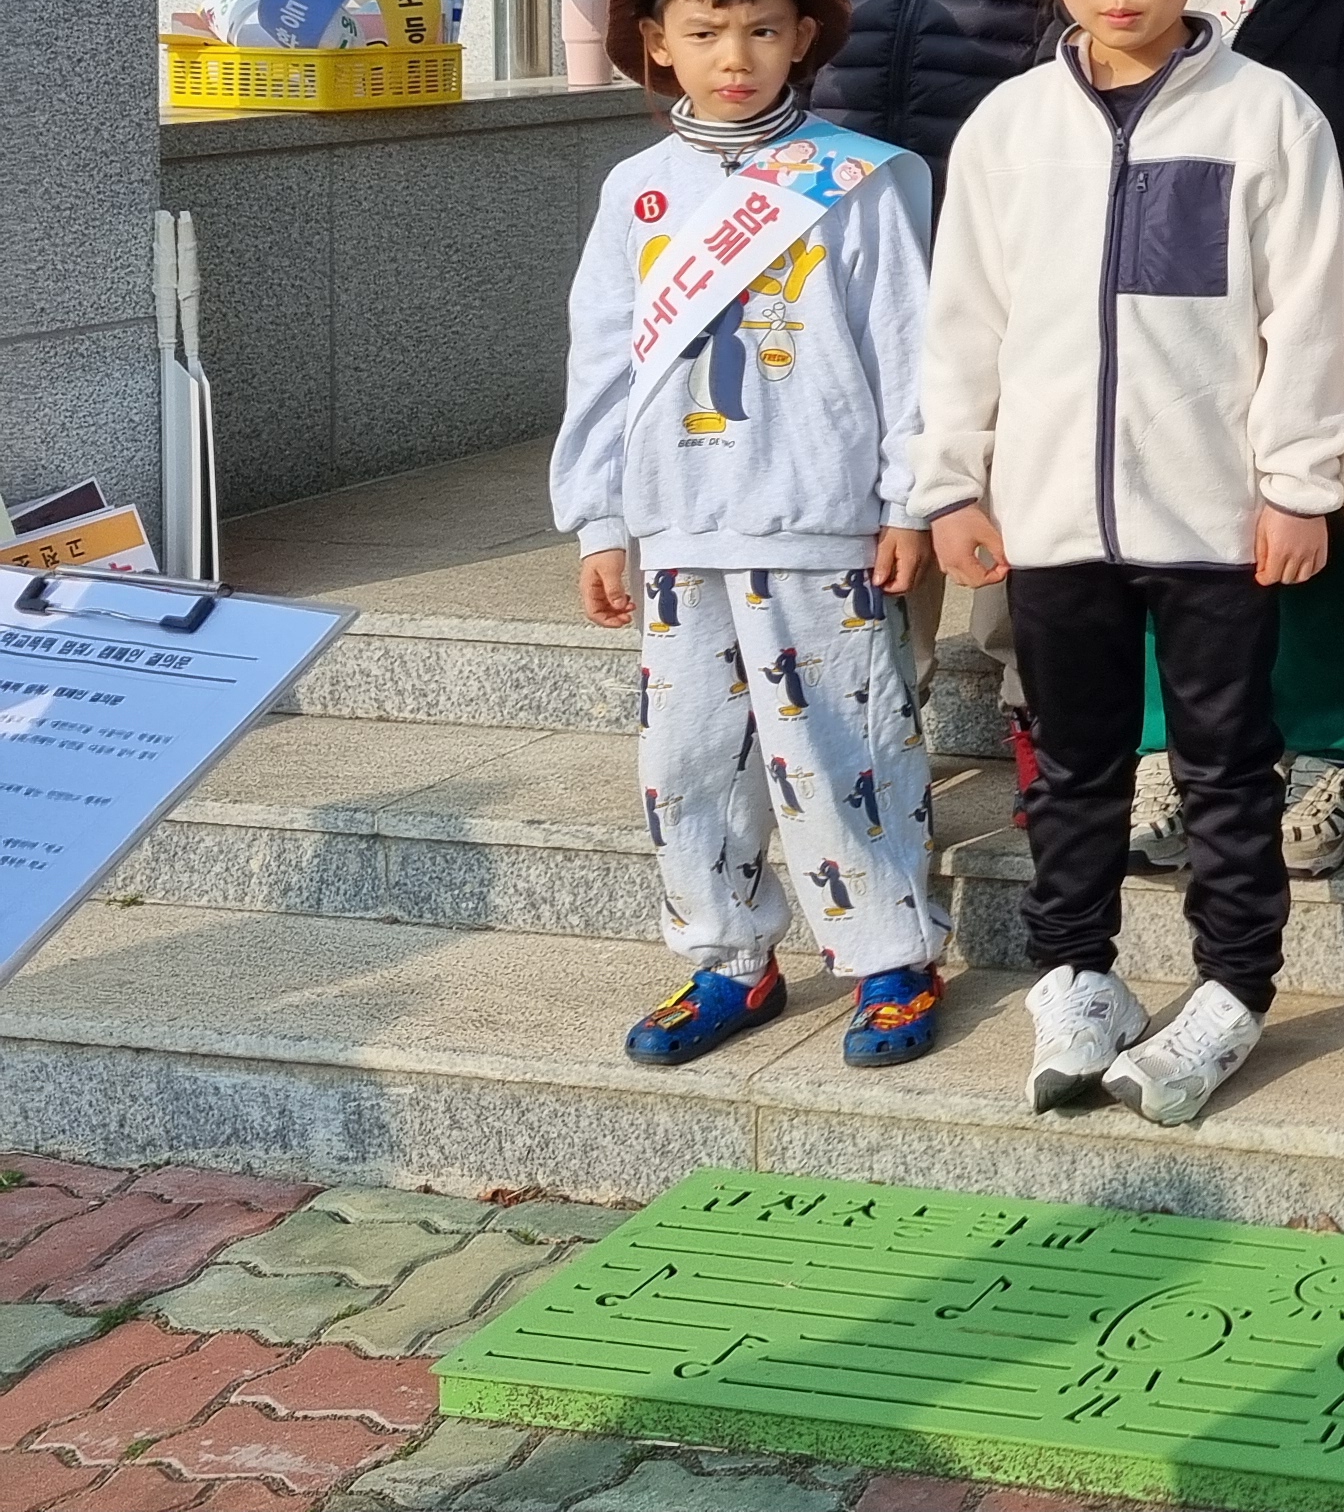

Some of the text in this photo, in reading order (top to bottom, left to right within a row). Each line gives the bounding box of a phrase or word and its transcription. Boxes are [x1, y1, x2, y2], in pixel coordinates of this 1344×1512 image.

[641, 193, 662, 220] B
[704, 191, 780, 267] 함께
[681, 1182, 1102, 1250] 고전초등학교
